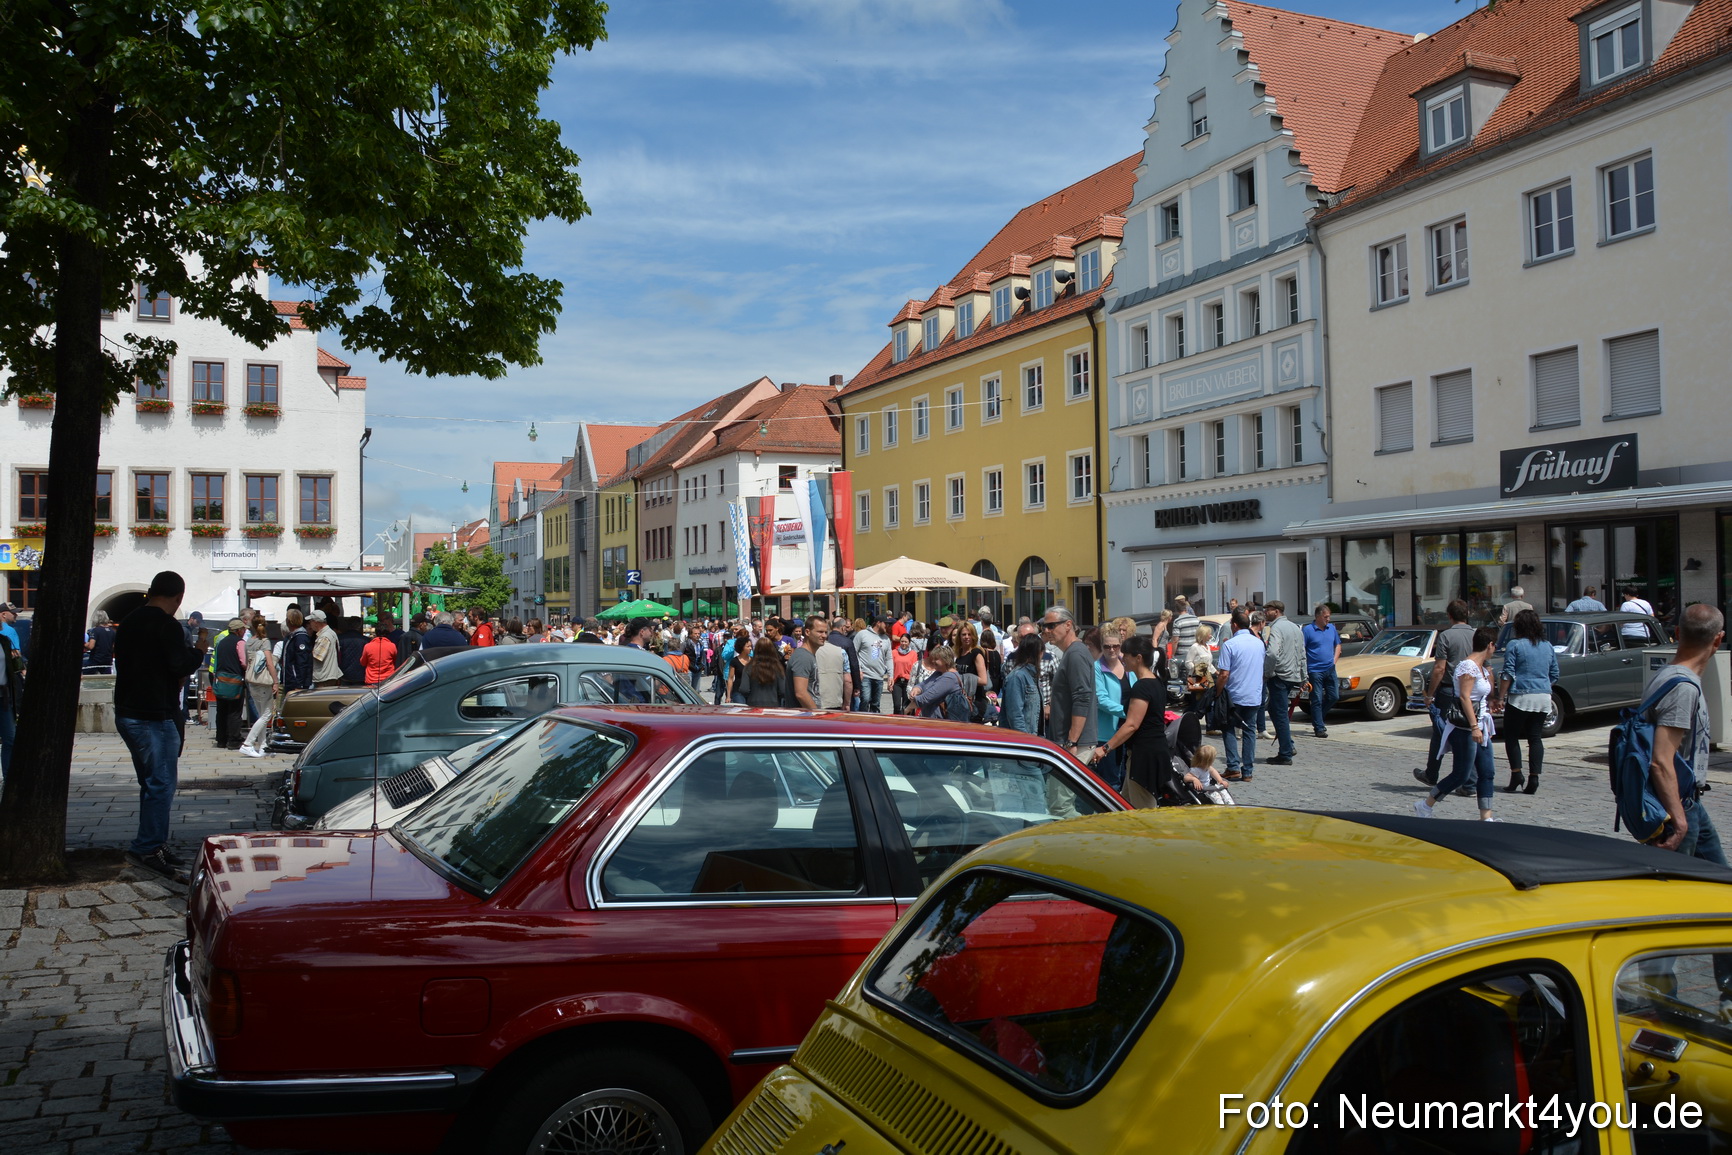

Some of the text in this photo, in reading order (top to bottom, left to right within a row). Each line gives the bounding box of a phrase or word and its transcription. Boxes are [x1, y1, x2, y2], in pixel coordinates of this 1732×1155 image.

[1169, 365, 1257, 402] BRILLEN WEBER
[1504, 441, 1629, 493] frühauf
[1154, 498, 1262, 529] BRILLEN WEBER
